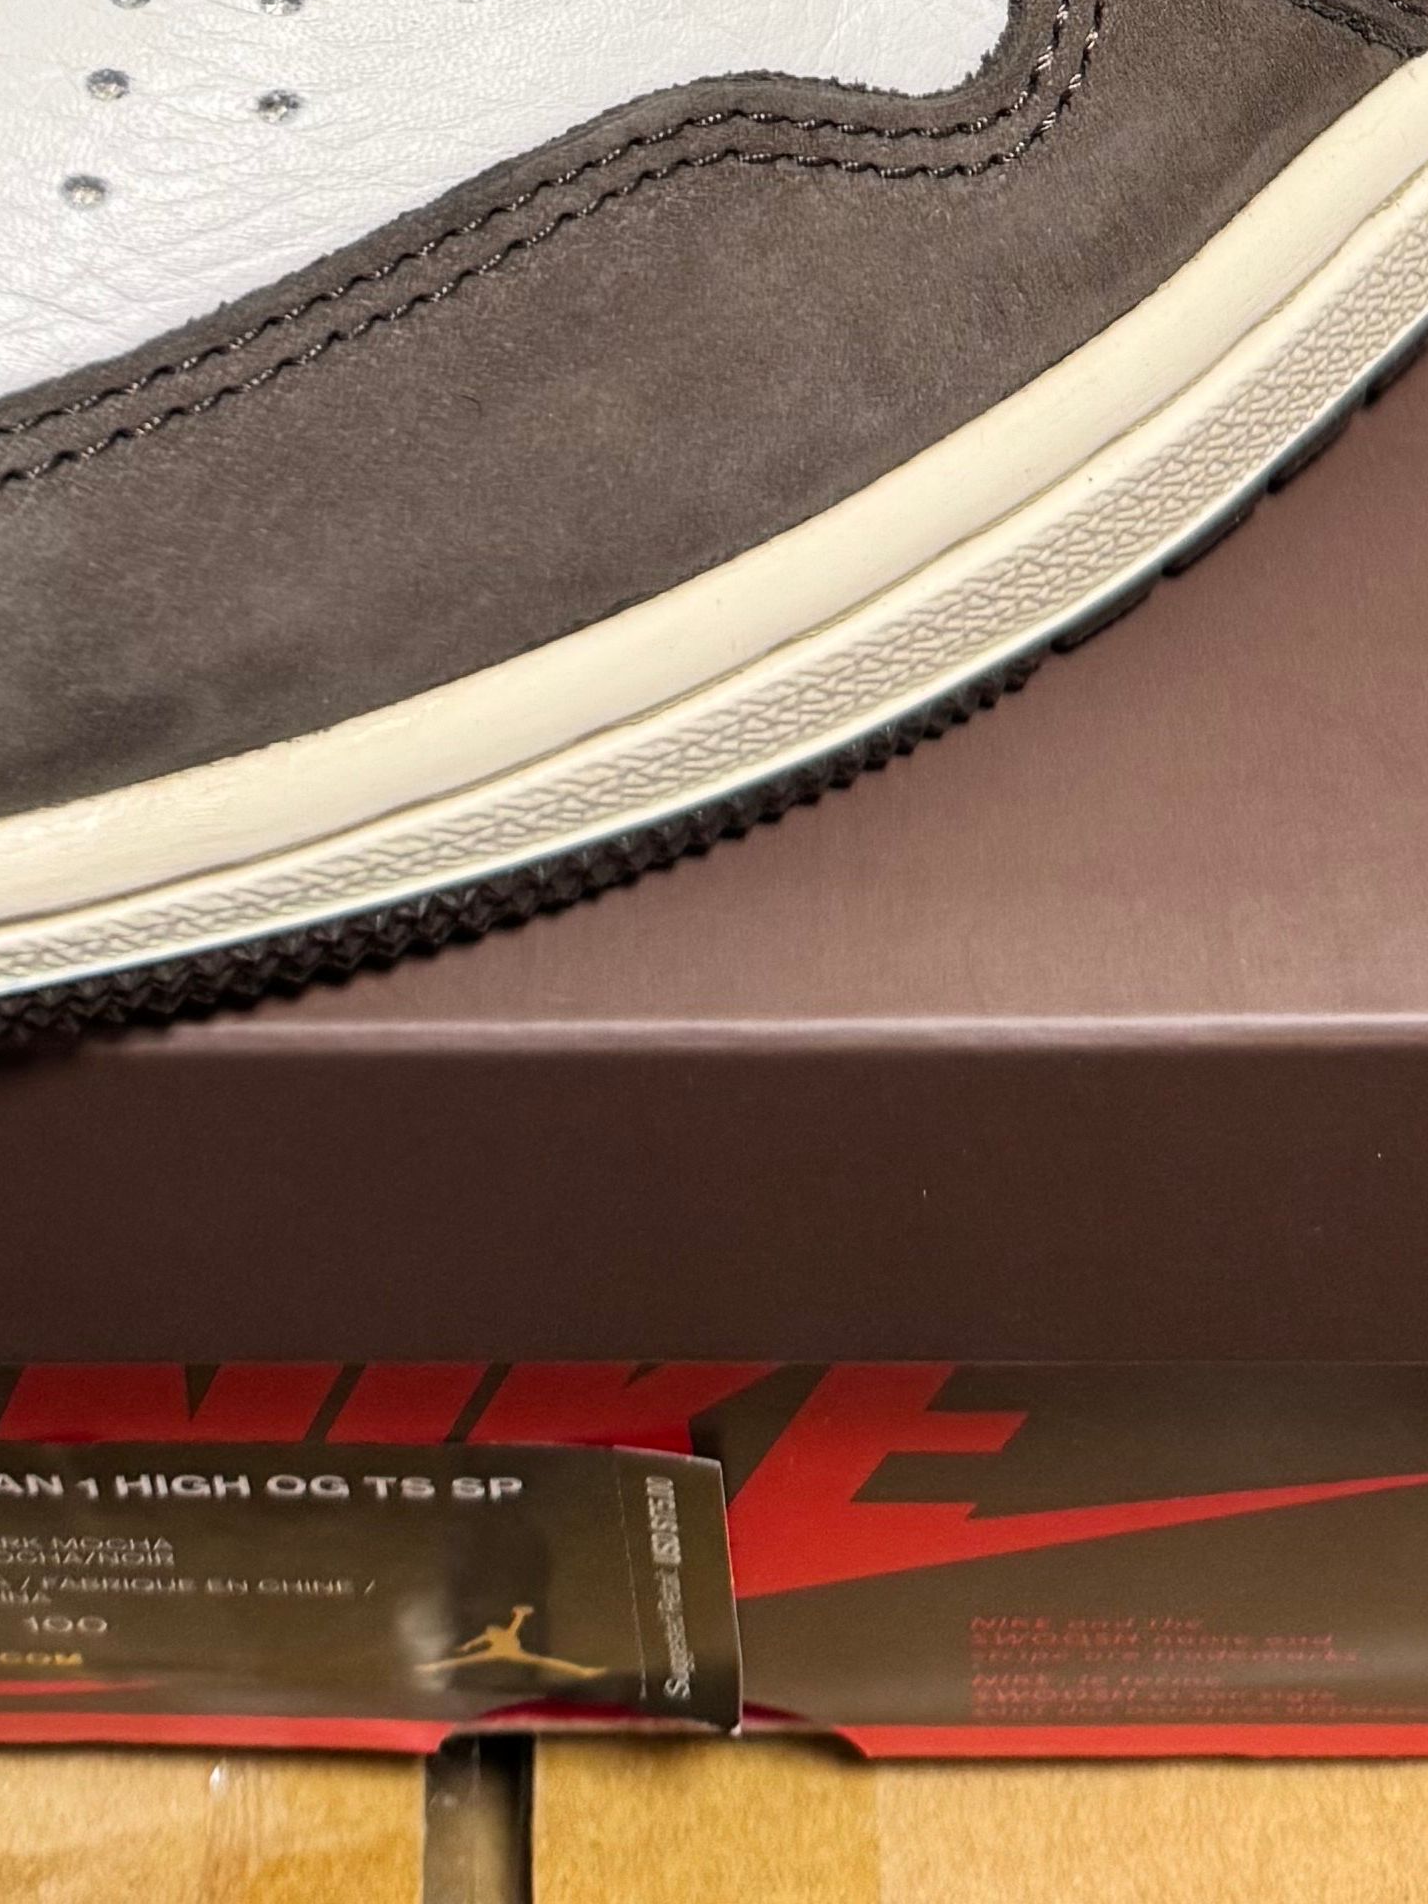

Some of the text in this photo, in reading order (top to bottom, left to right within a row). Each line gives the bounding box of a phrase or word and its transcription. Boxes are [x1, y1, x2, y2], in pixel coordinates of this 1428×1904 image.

[74, 1476, 100, 1501] 1
[114, 1473, 253, 1501] HIGH
[264, 1473, 351, 1500] OG
[362, 1475, 437, 1502] TS
[450, 1475, 524, 1503] SP
[50, 1535, 174, 1552] MOCHA
[24, 1614, 108, 1634] 100
